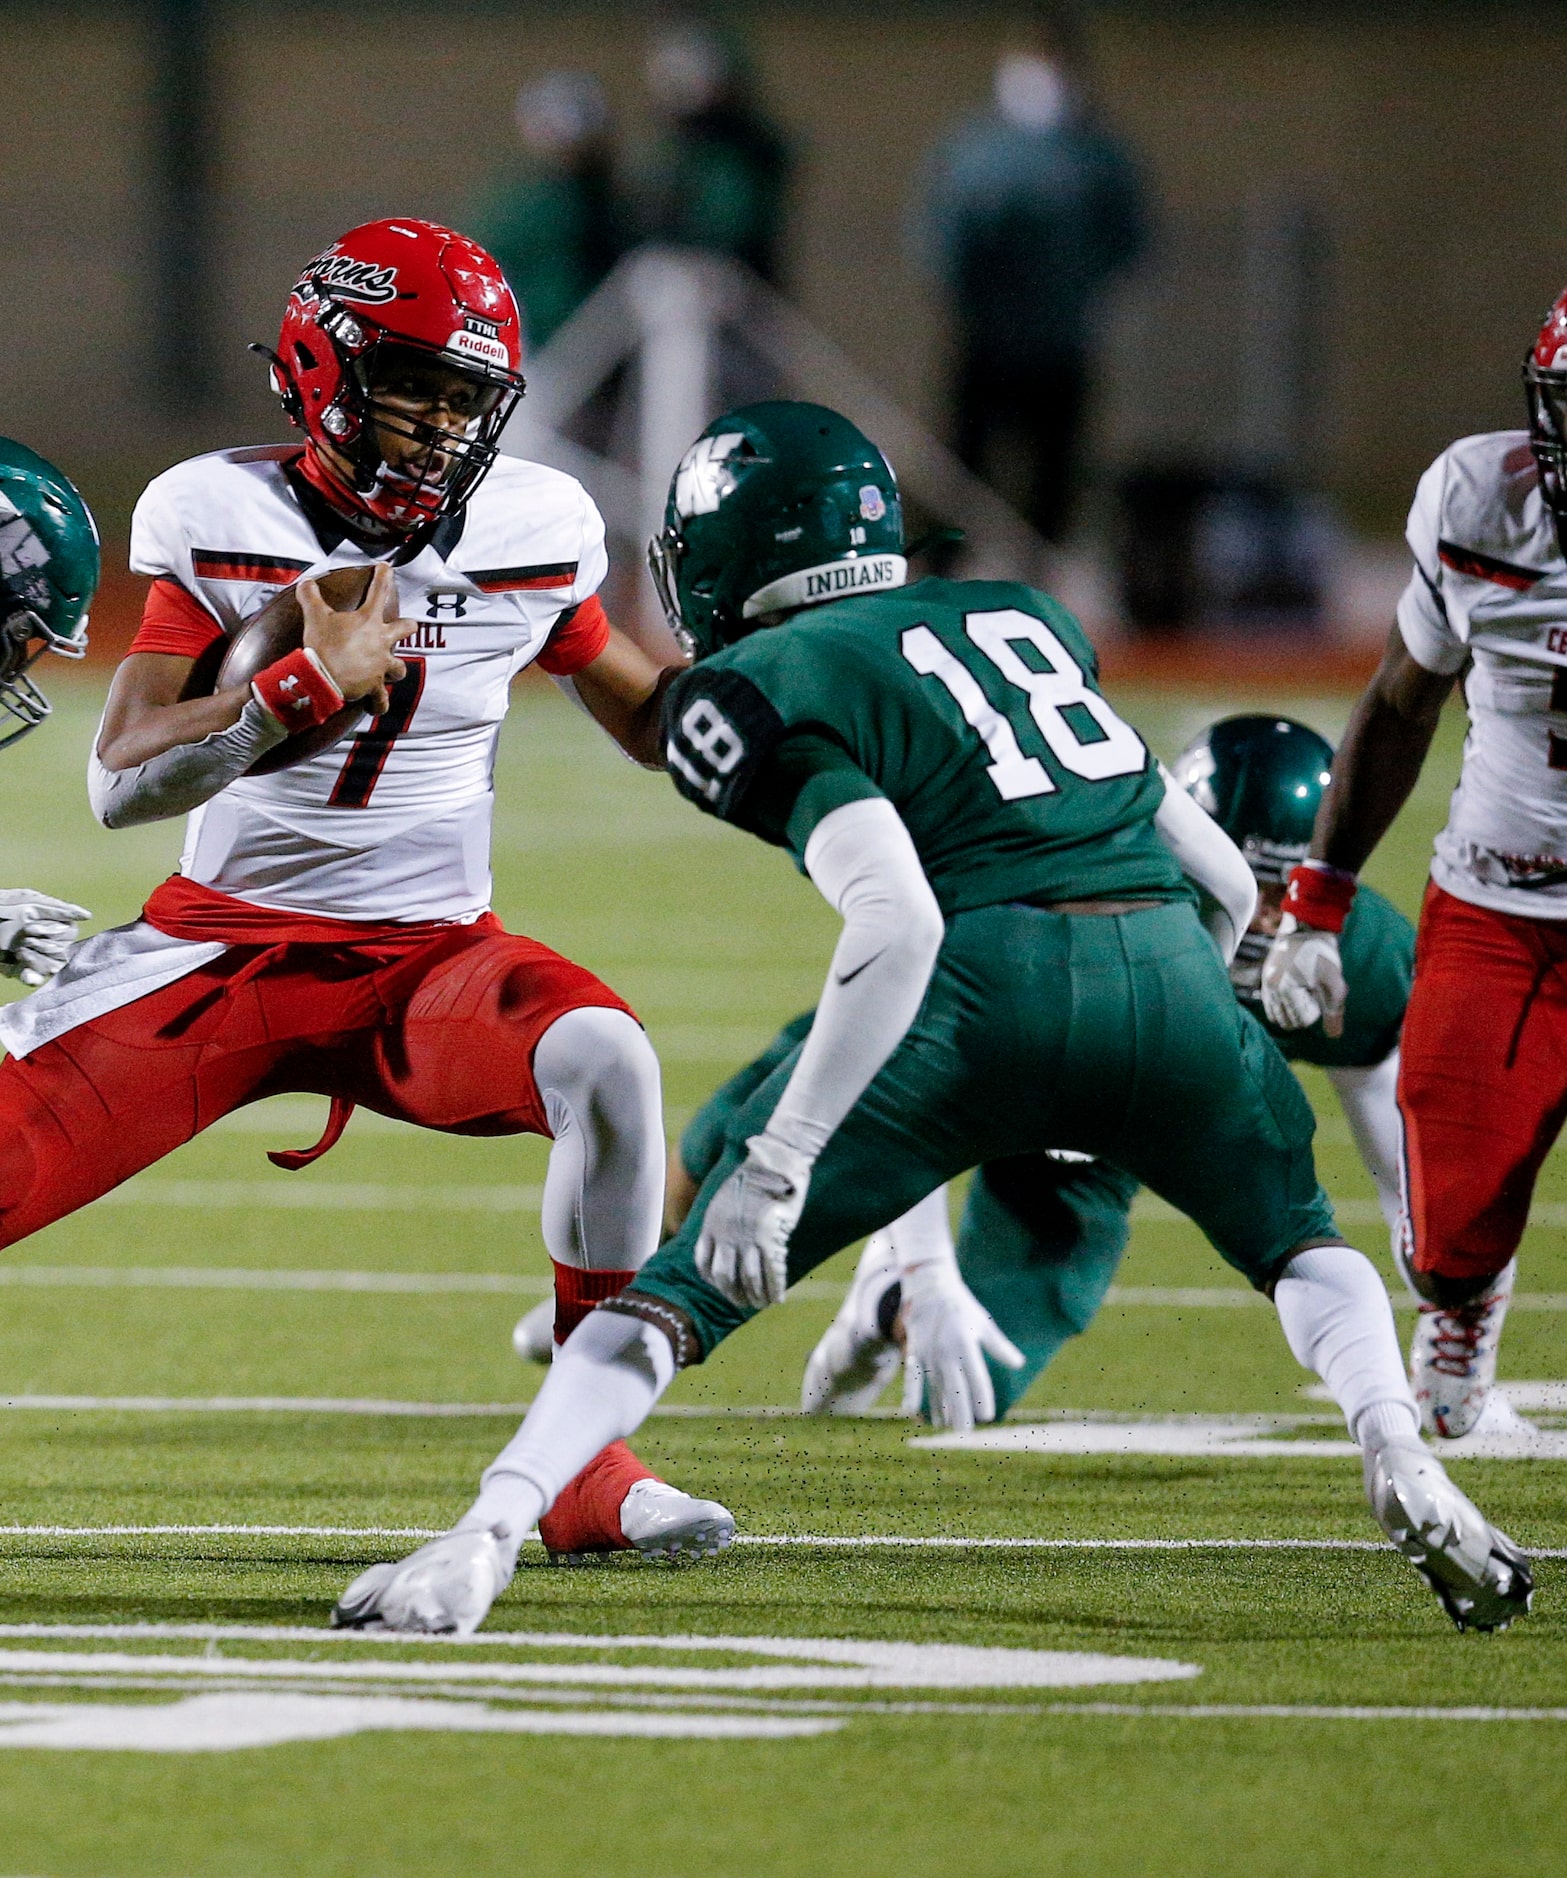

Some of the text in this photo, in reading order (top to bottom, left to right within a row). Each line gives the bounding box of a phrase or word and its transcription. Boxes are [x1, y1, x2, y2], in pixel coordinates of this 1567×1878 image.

[465, 317, 499, 339] TTHL
[458, 334, 505, 360] Riddell
[807, 561, 893, 596] INDIANS
[901, 608, 1147, 801] 18
[666, 698, 745, 801] 18
